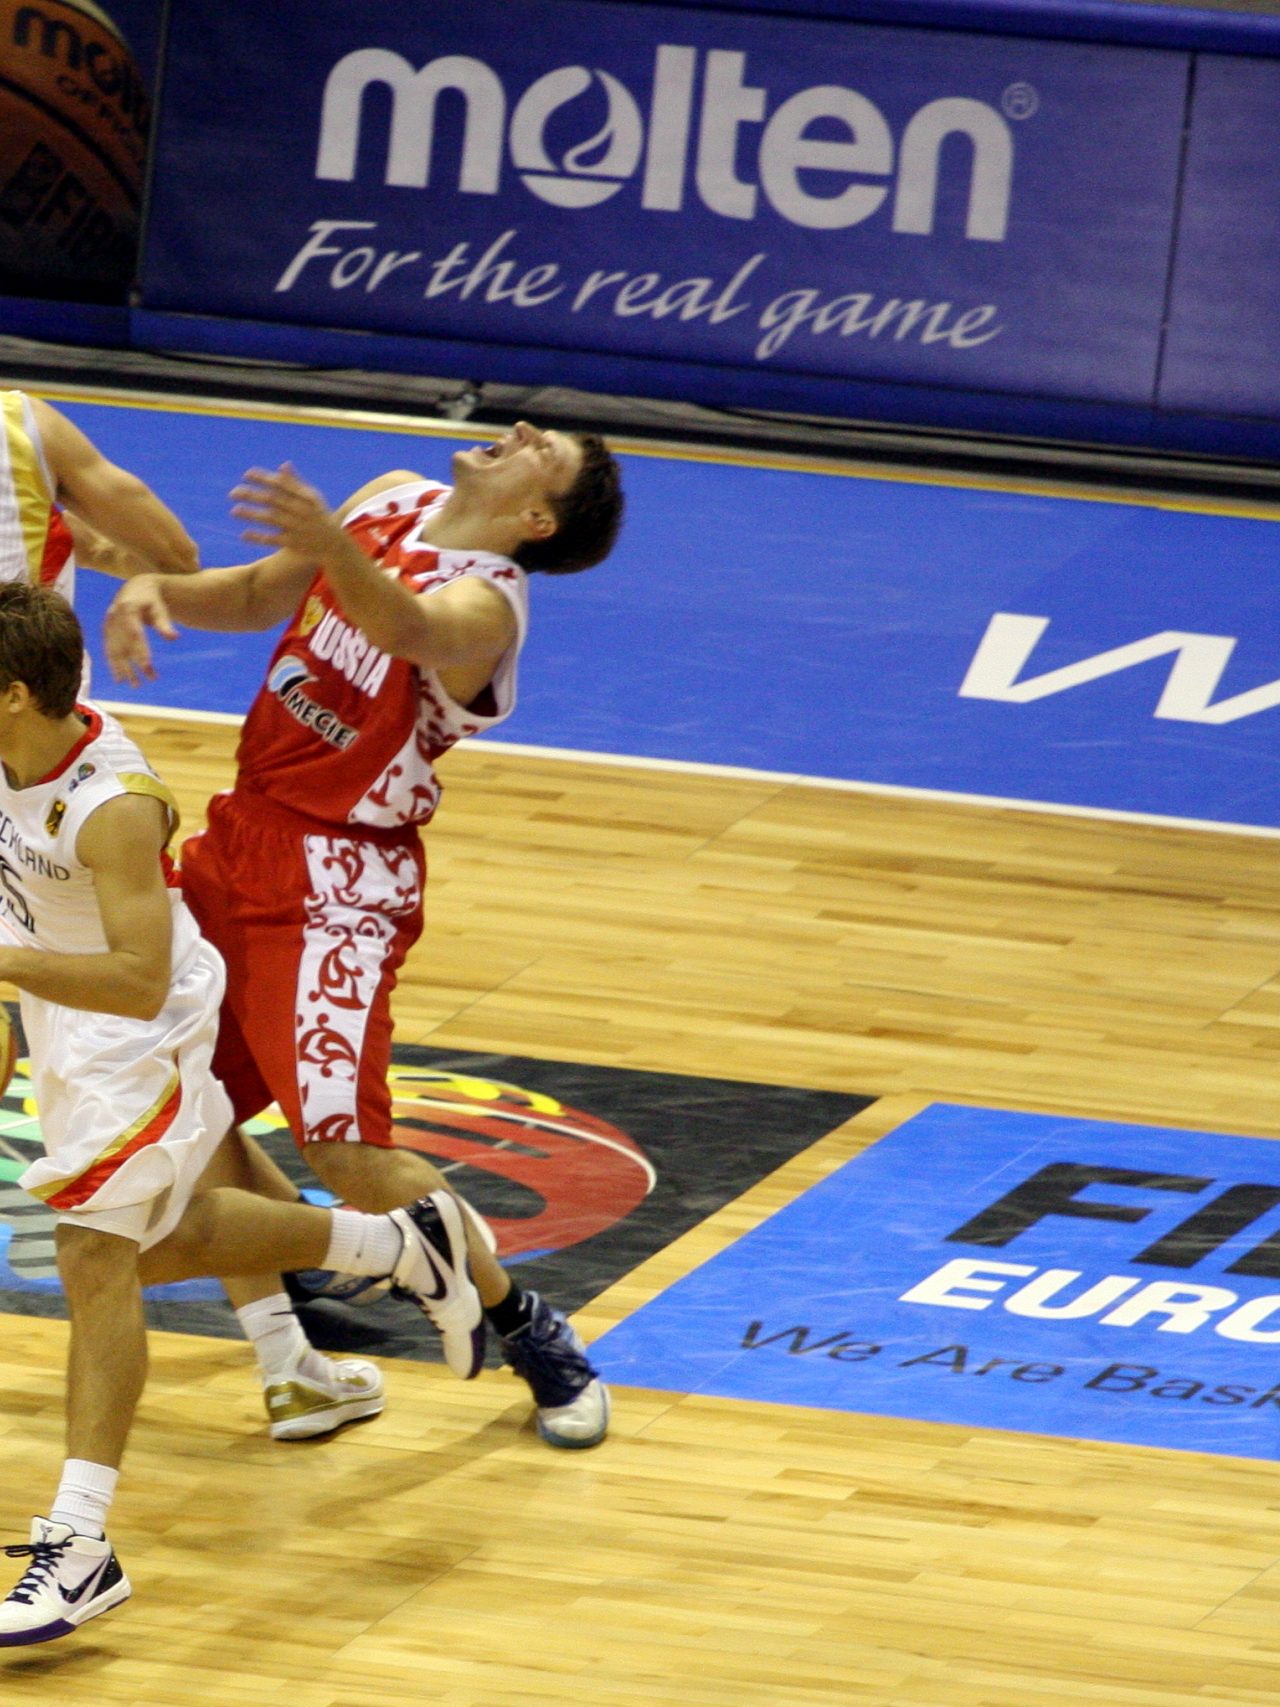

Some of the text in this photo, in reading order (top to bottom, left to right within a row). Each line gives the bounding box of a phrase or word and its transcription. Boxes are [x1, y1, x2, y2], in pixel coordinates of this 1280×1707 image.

[316, 44, 1012, 242] molten
[274, 219, 1004, 361] For the real game
[740, 1320, 883, 1362] We
[897, 1344, 1066, 1383] Are
[898, 1258, 1280, 1344] EURO
